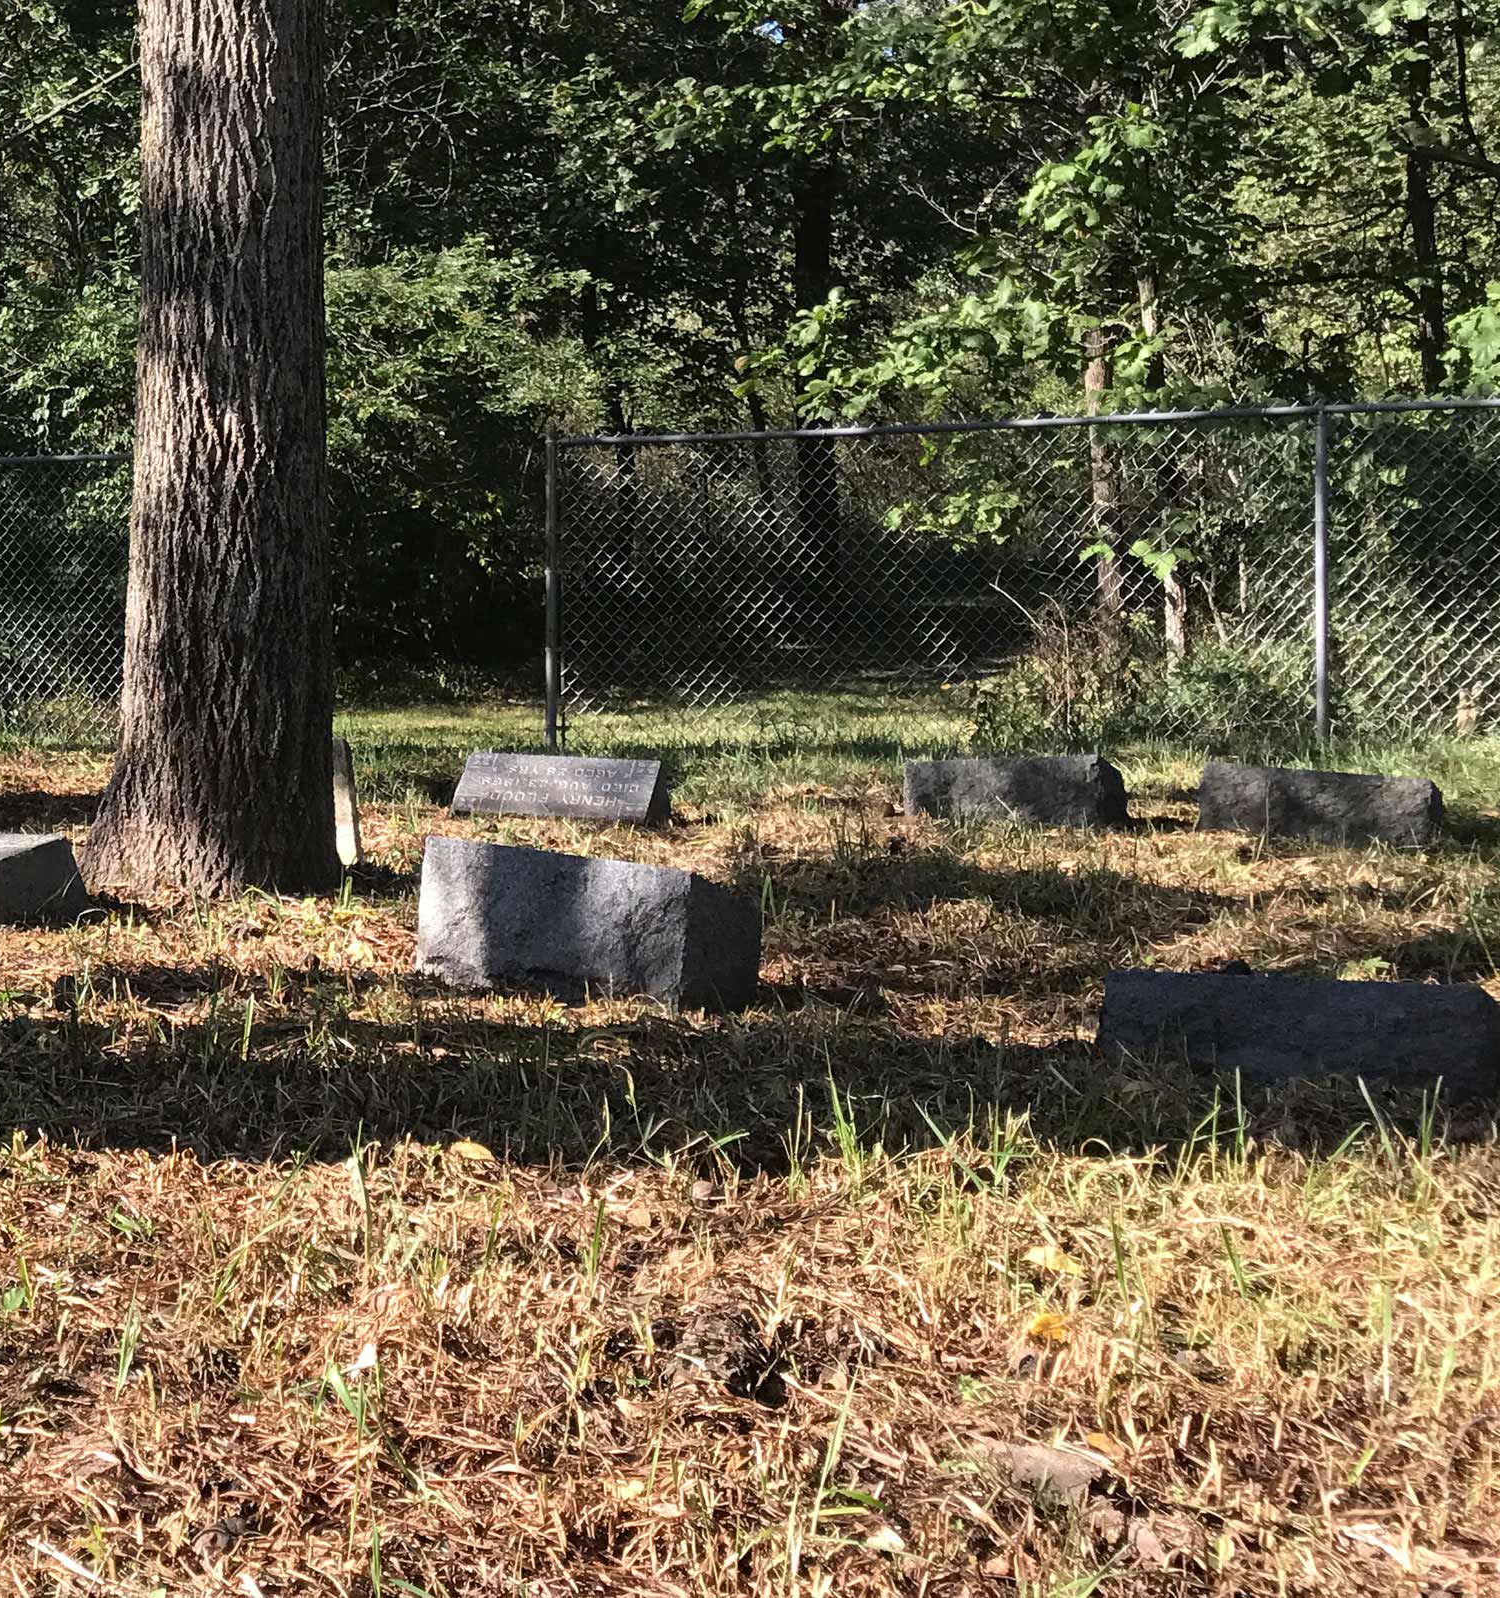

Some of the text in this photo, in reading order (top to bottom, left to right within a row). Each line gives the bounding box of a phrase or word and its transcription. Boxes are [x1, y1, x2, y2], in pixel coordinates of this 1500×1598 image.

[574, 768, 616, 779] AGED
[602, 783, 640, 793] DIED
[487, 790, 617, 807] HENRY FLOOD
